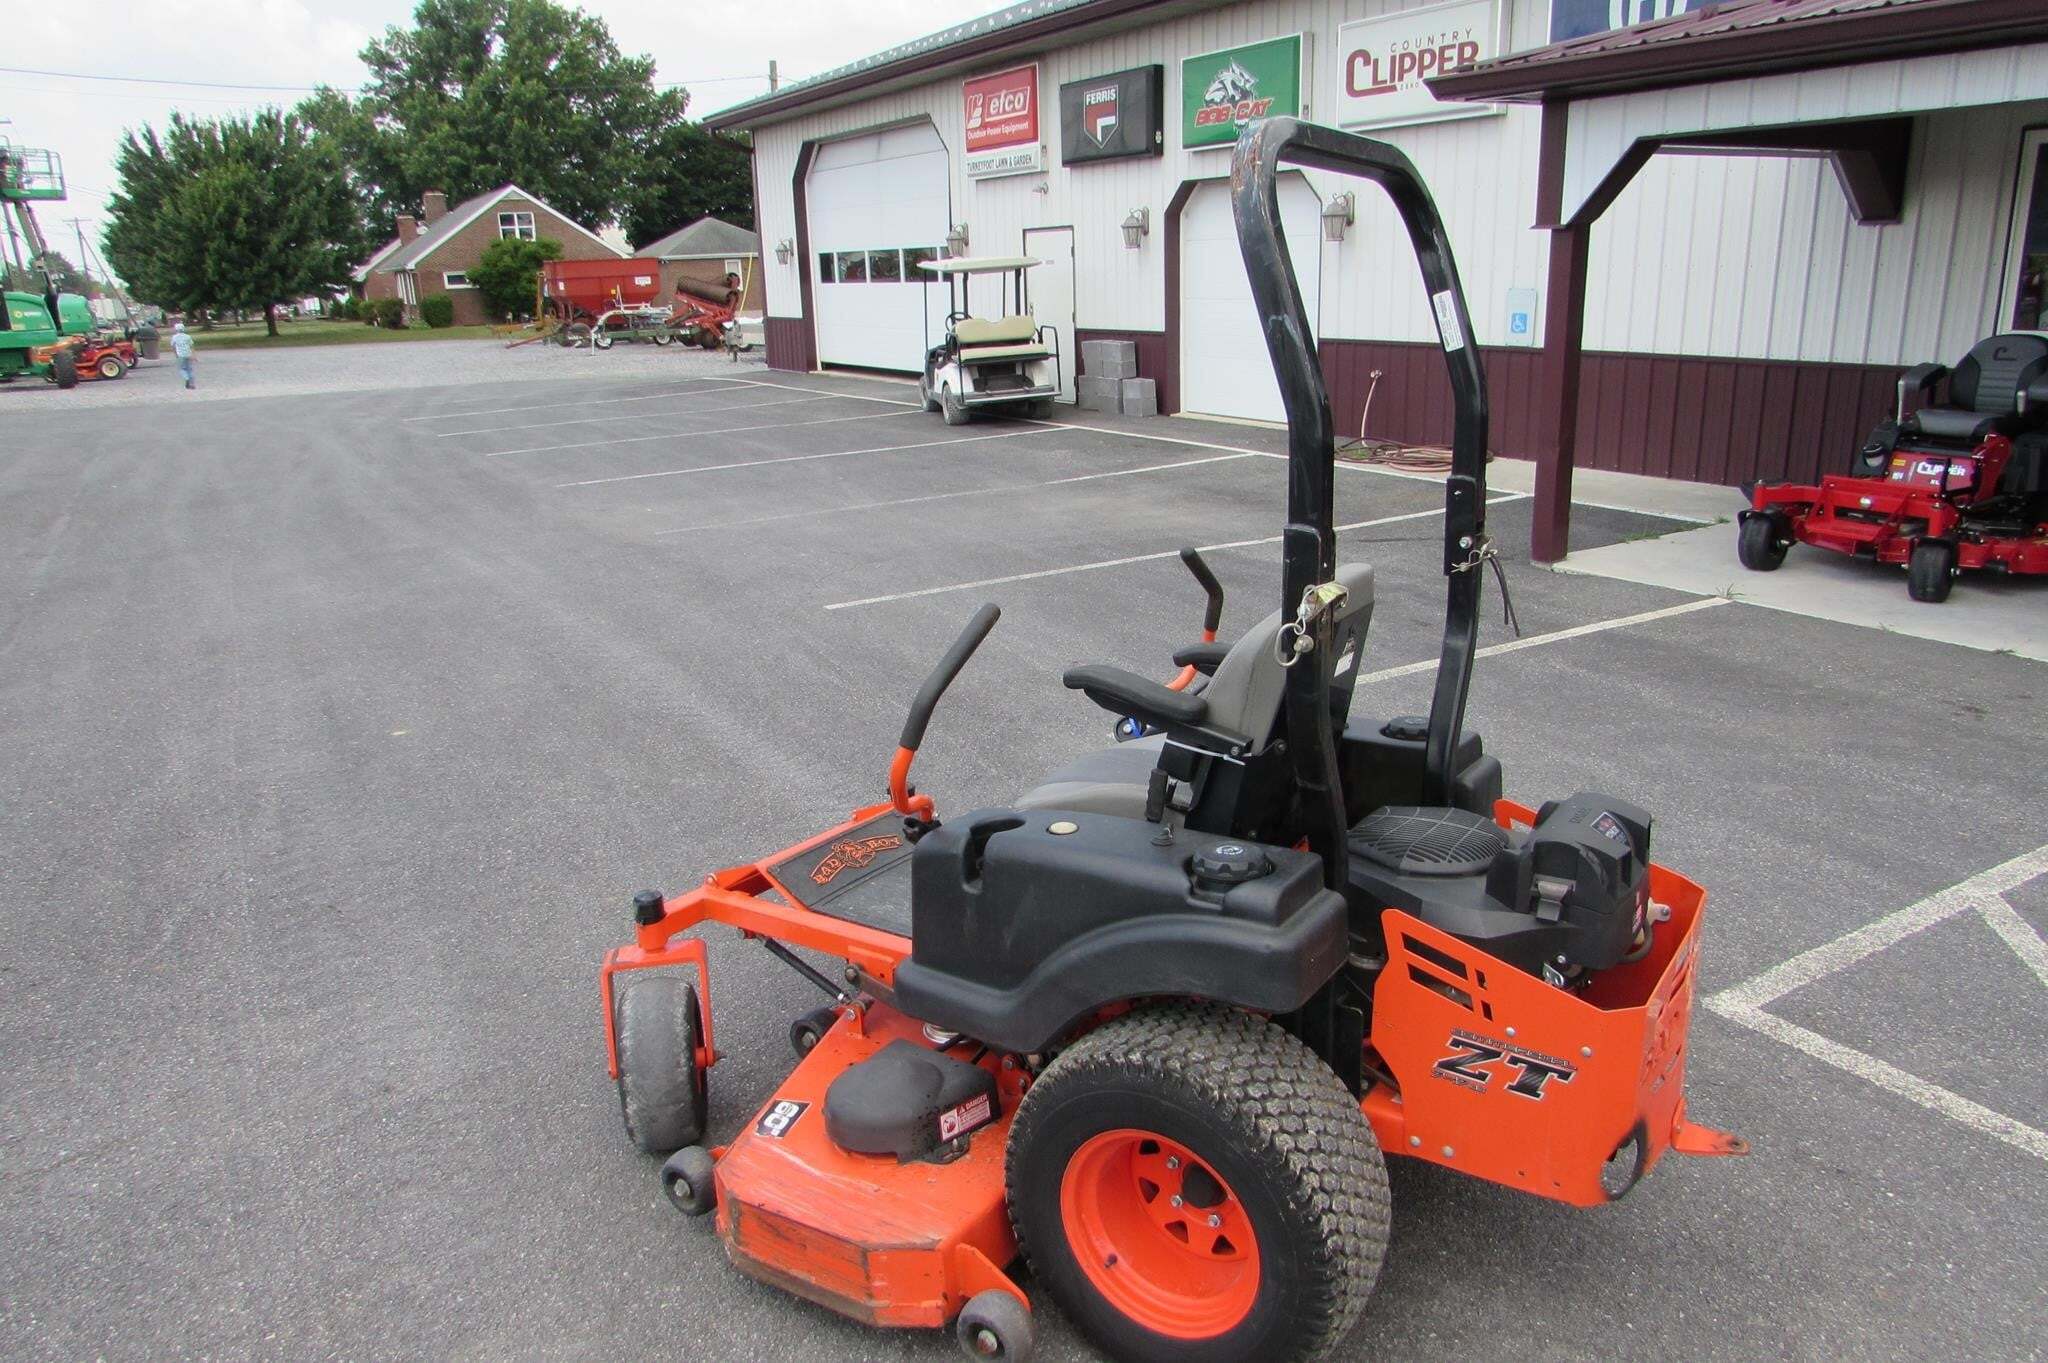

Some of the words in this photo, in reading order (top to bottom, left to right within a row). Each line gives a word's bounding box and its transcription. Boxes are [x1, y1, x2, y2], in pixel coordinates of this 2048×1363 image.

[1390, 27, 1472, 53] COUNTRY
[1346, 41, 1480, 98] CLIPPER
[989, 89, 1025, 116] efco
[1086, 88, 1116, 106] FERRIS
[967, 129, 987, 140] Outdoor
[987, 126, 1002, 137] Power
[1002, 121, 1029, 135] Equipment
[995, 157, 1008, 169] LAWN
[1014, 154, 1033, 166] GARDEN
[813, 857, 842, 884] BAD
[866, 836, 900, 852] BOY
[1434, 1035, 1578, 1101] ZT
